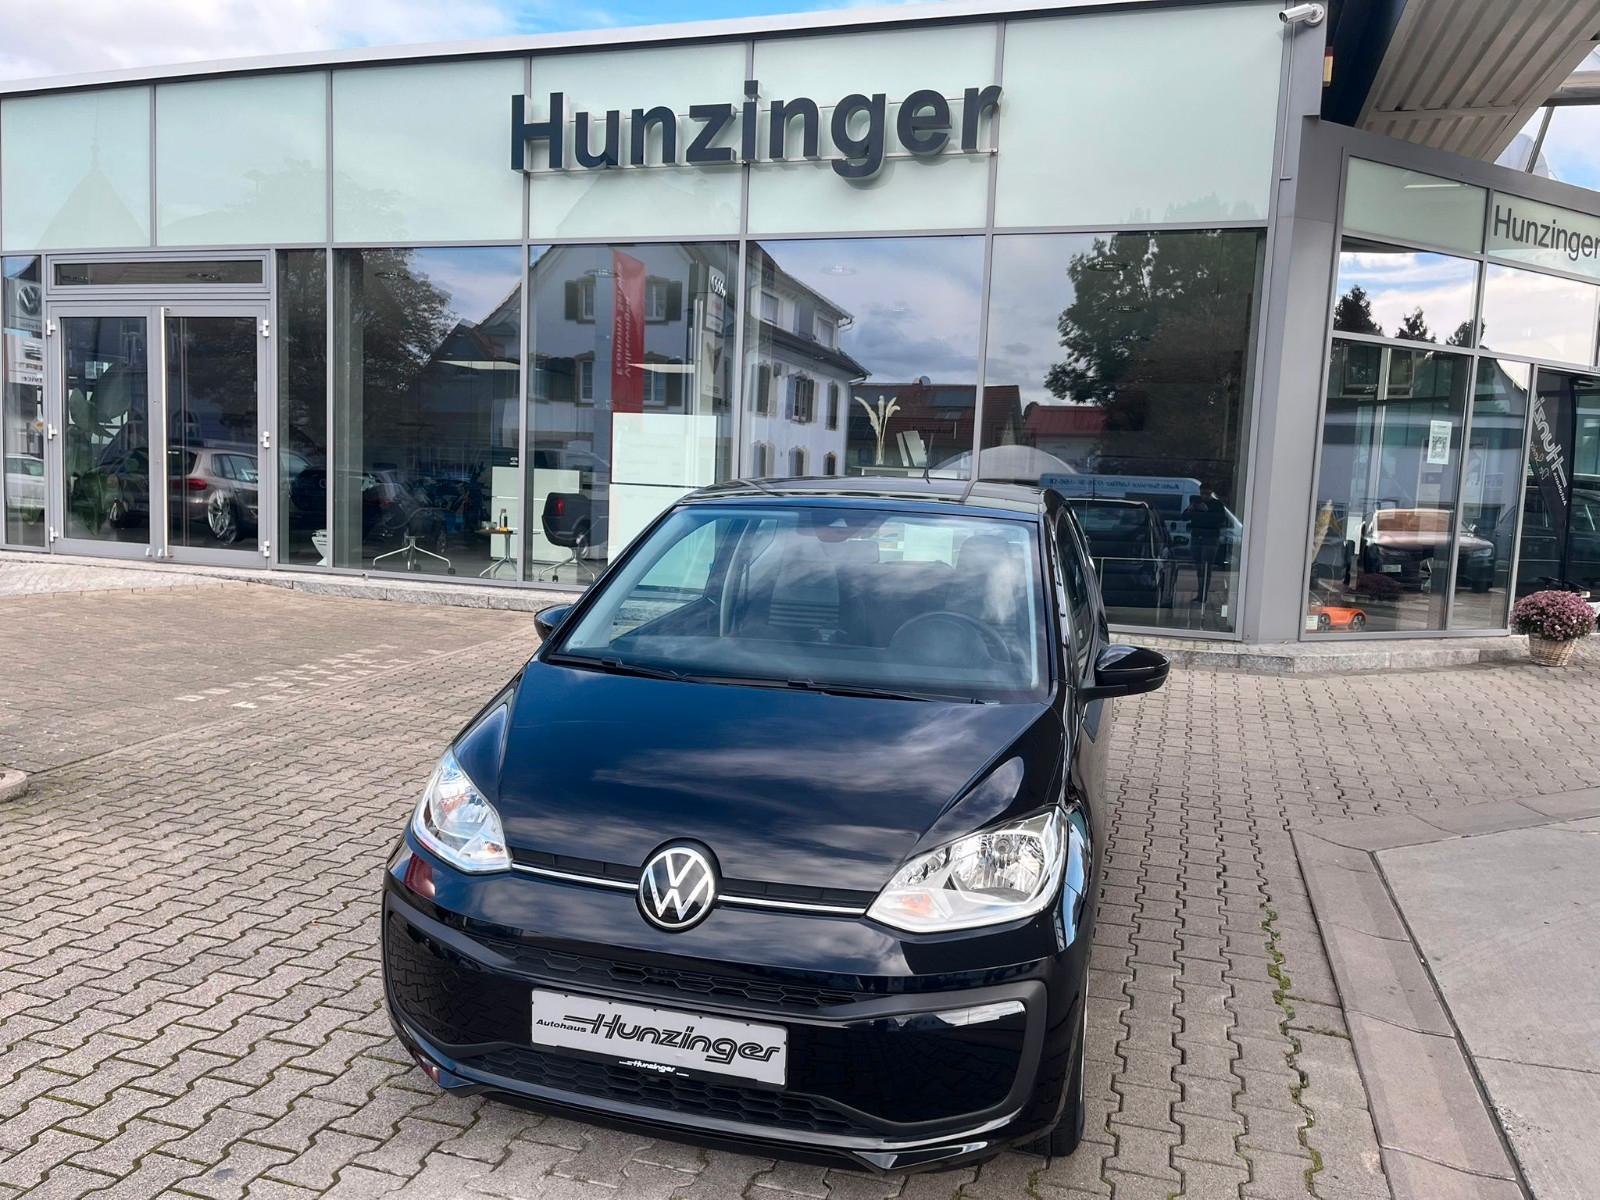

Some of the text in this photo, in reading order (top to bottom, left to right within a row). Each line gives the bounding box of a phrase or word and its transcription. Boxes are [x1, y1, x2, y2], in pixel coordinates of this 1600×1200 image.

[511, 79, 1002, 179] Hunzinger
[536, 1013, 781, 1065] Autohaus Hunzinger
[620, 1060, 676, 1073] Hunzinger
